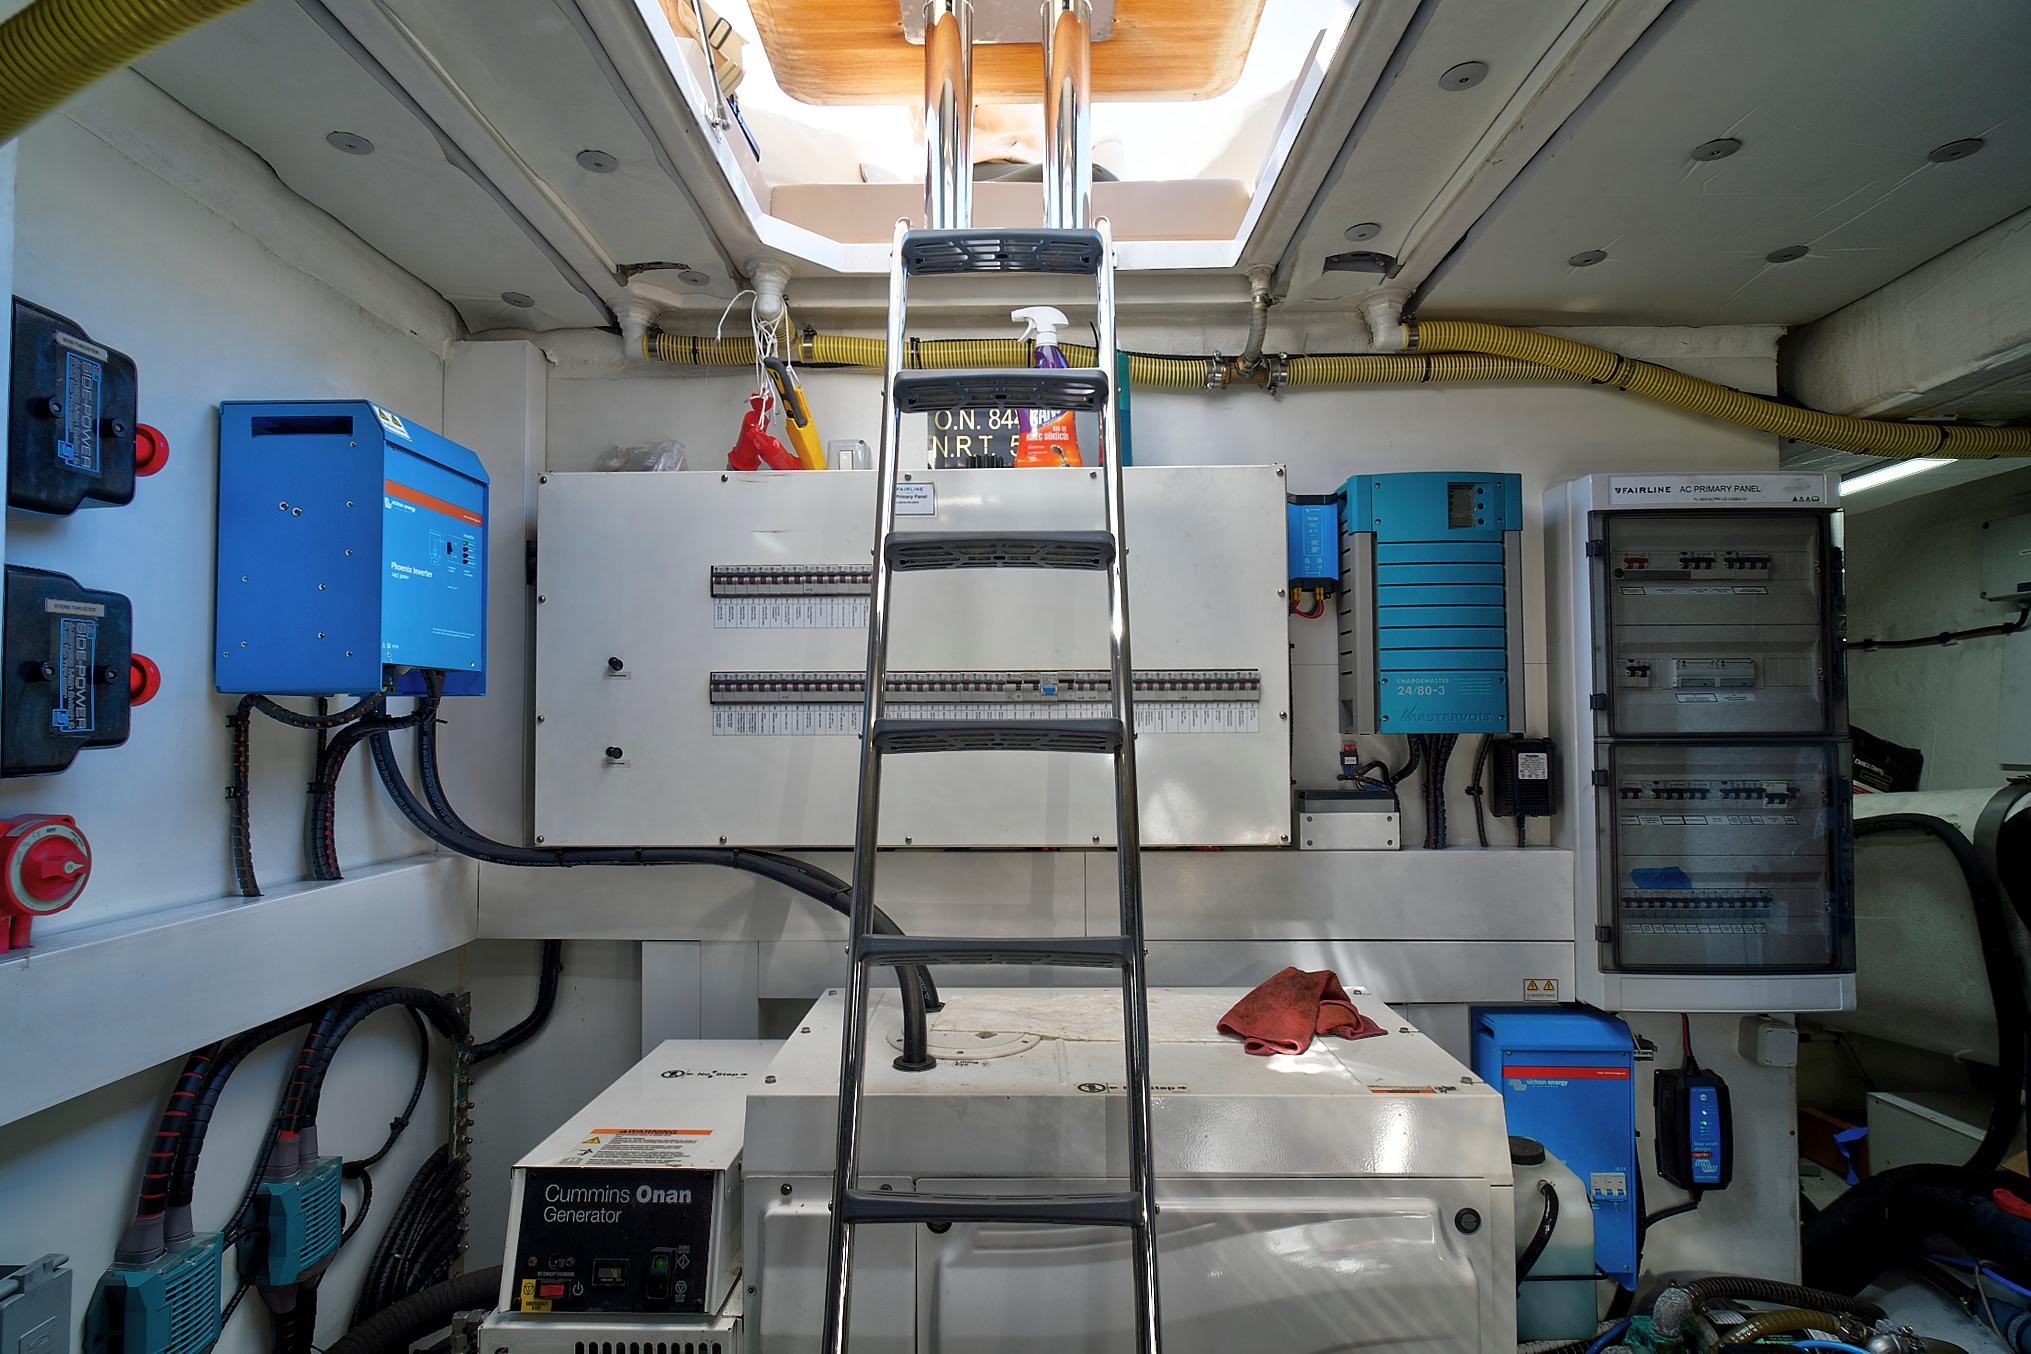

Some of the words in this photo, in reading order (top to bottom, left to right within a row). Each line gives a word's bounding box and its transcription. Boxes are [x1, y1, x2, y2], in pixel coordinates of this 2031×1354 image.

[934, 409, 981, 430] O.N.
[932, 435, 996, 458] N.R.T.
[1622, 486, 1671, 494] FAIRLINE
[1694, 485, 1732, 493] PRIMARY
[1734, 485, 1761, 493] PANEL
[391, 561, 412, 574] Phoenix
[1397, 686, 1446, 696] 24/80-3
[544, 1184, 631, 1203] Cummins
[636, 1185, 692, 1203] Onan
[543, 1206, 623, 1223] Generator
